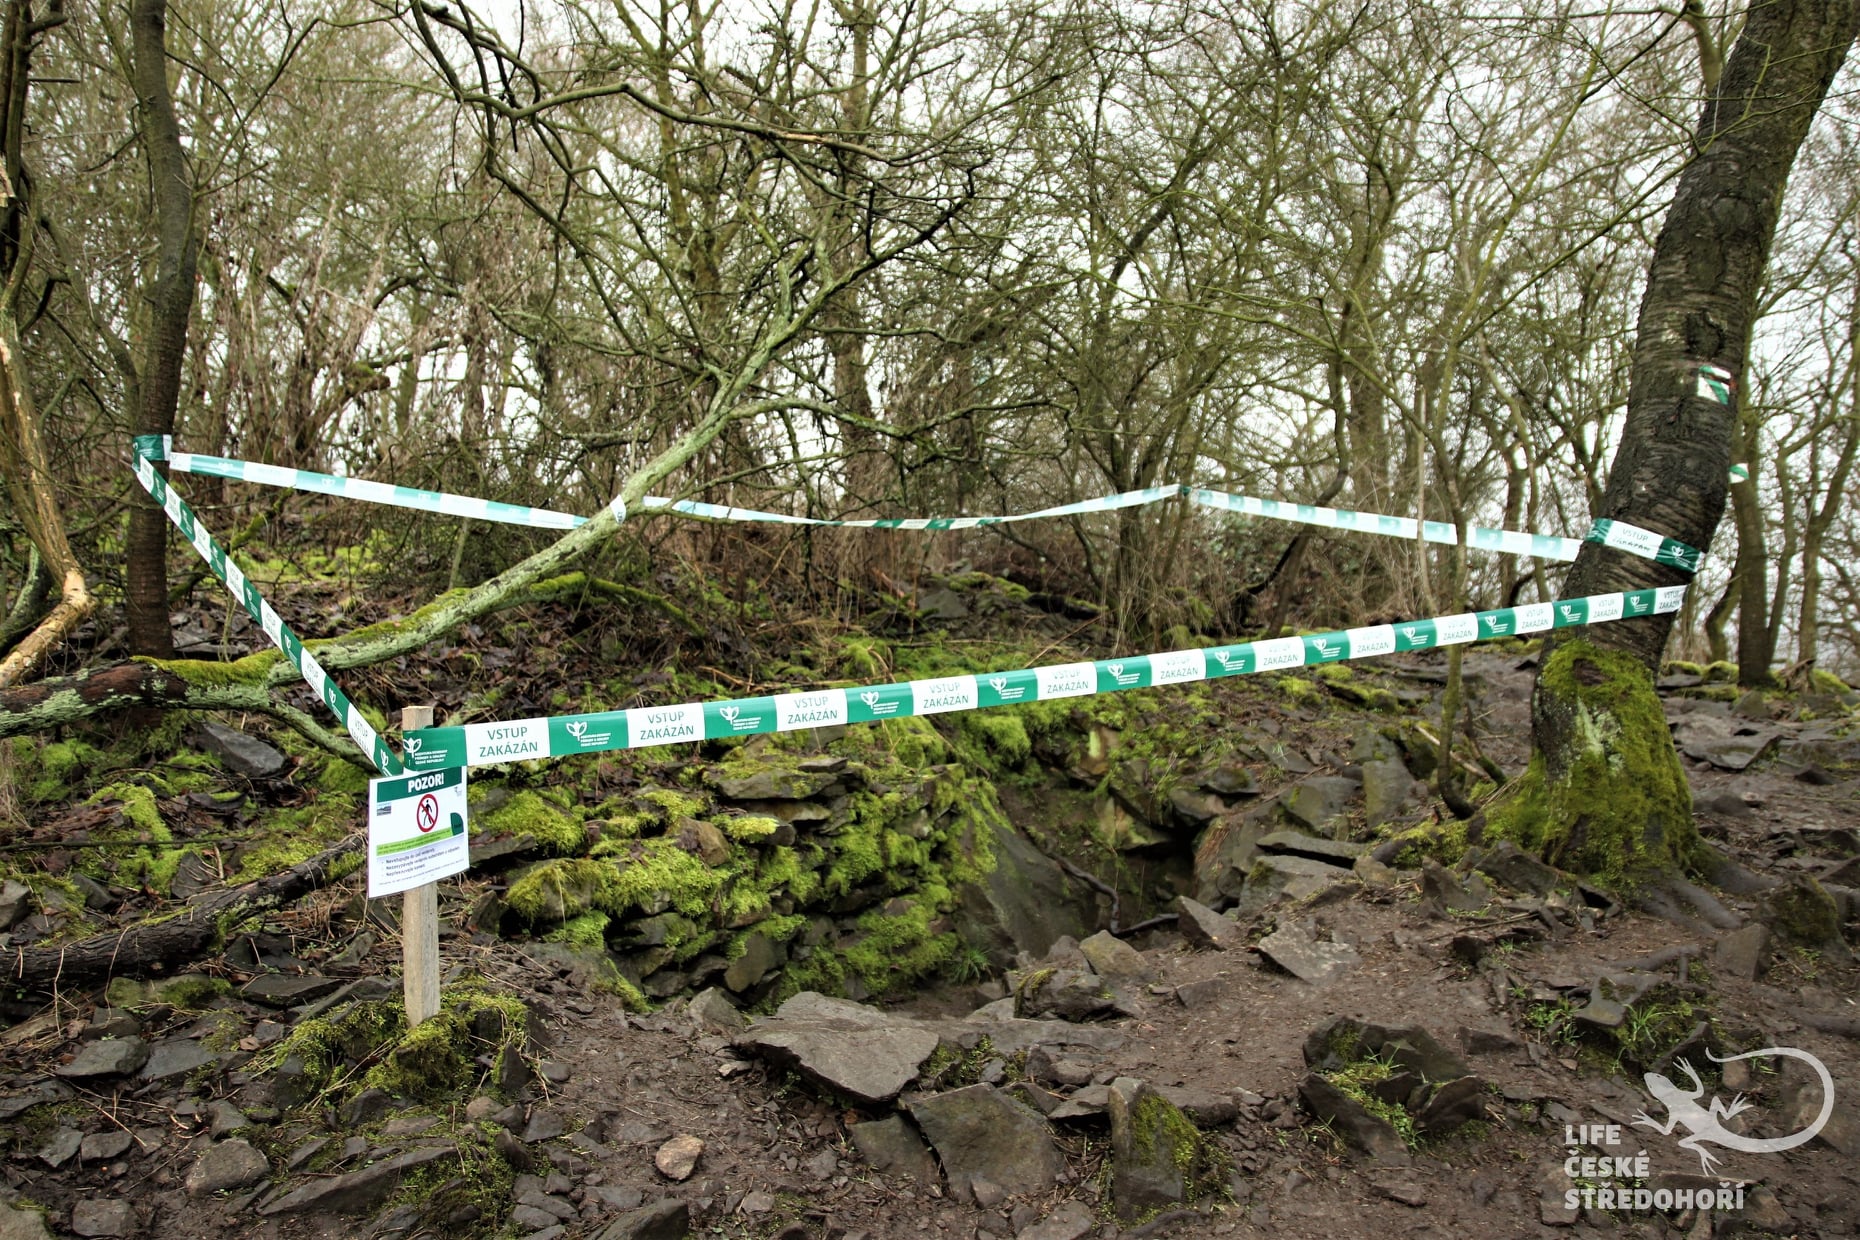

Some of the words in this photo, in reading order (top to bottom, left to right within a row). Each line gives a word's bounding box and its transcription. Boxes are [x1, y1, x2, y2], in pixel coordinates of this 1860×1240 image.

[929, 681, 961, 694] VSTUP
[794, 695, 829, 709] VSTUP
[647, 710, 685, 724] VSTUP
[787, 707, 838, 724] ZAKÁZÁN
[487, 726, 528, 741] VSTUP
[639, 723, 694, 740] ZAKÁZÁN
[479, 739, 538, 758] ZAKÁZÁN
